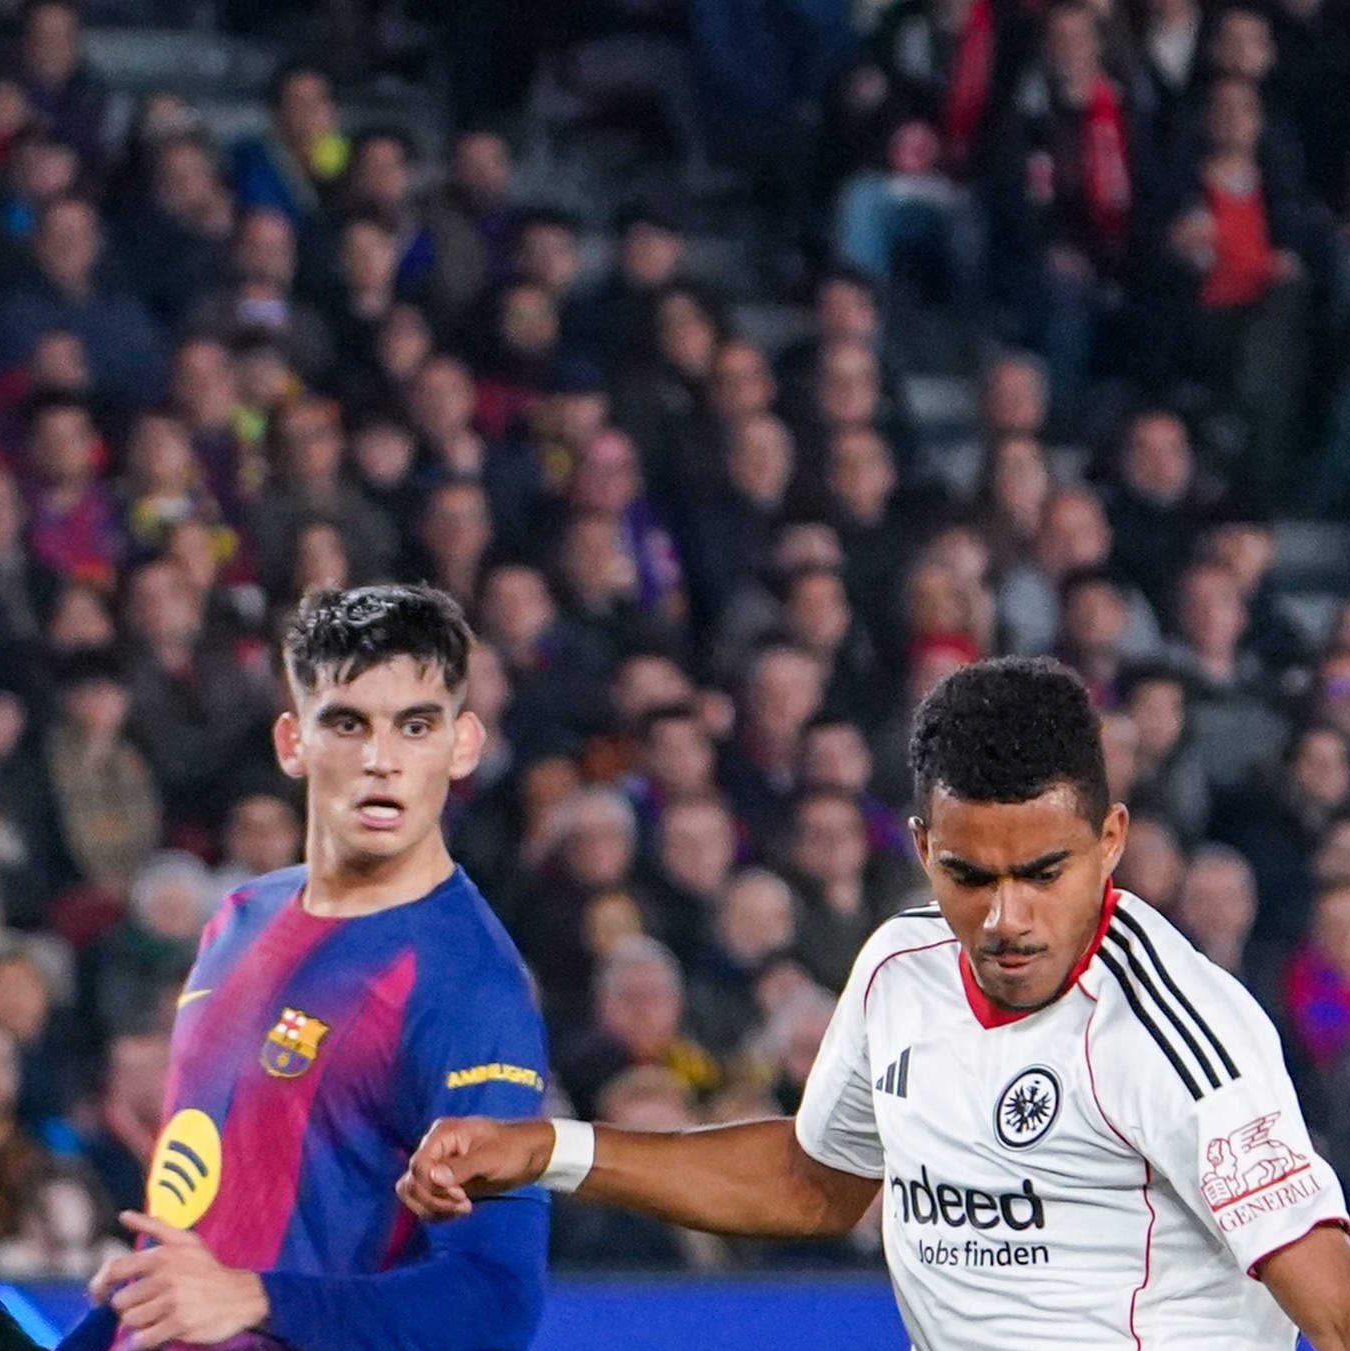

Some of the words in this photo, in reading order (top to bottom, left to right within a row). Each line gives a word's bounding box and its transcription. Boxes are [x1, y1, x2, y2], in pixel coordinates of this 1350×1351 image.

[890, 1164, 1045, 1232] ndeed
[1219, 1174, 1321, 1233] GENERALI
[964, 1240, 1049, 1267] finden
